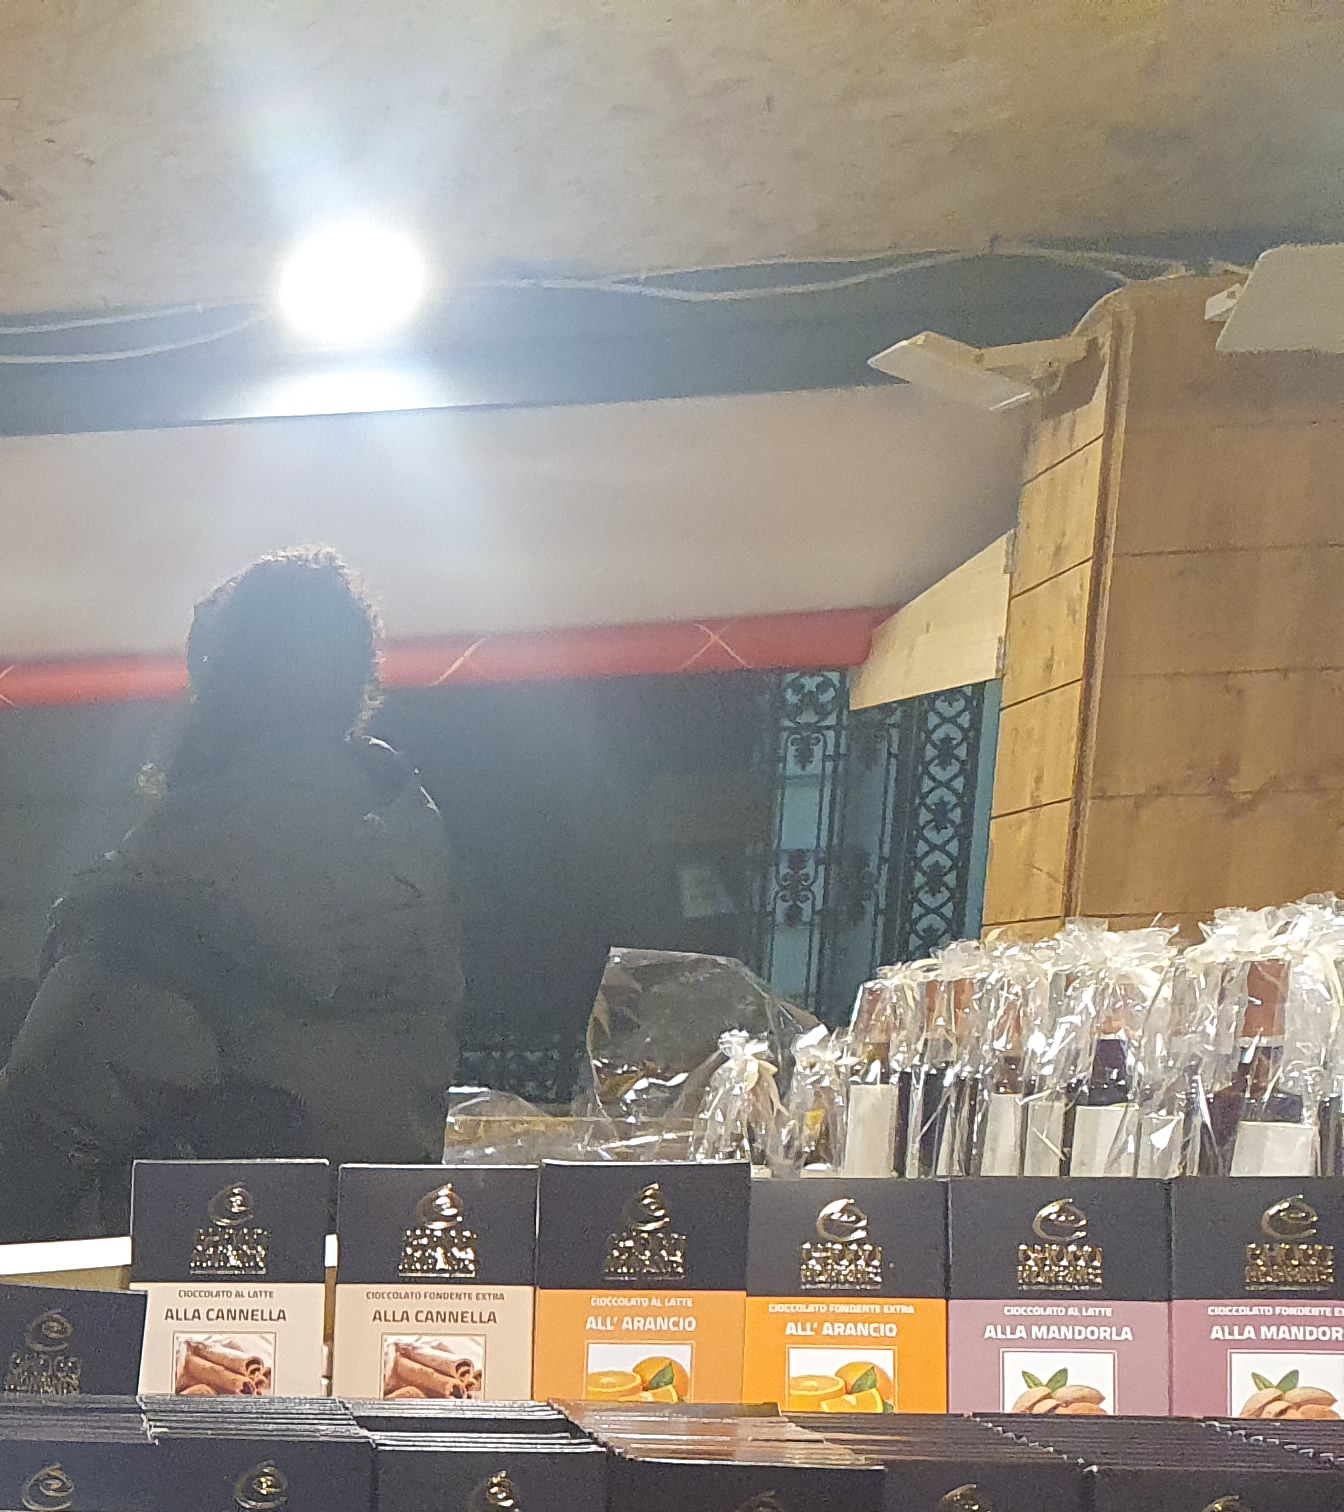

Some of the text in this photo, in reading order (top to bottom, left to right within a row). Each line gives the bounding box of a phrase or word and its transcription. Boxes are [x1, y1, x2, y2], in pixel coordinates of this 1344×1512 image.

[165, 1308, 286, 1322] ALLA CANNELLA
[372, 1310, 497, 1324] ALLA CANNELLA
[622, 1316, 696, 1331] ARANCIO
[822, 1323, 897, 1337] ARANCIO
[985, 1325, 1133, 1341] ALLA MANDORLA
